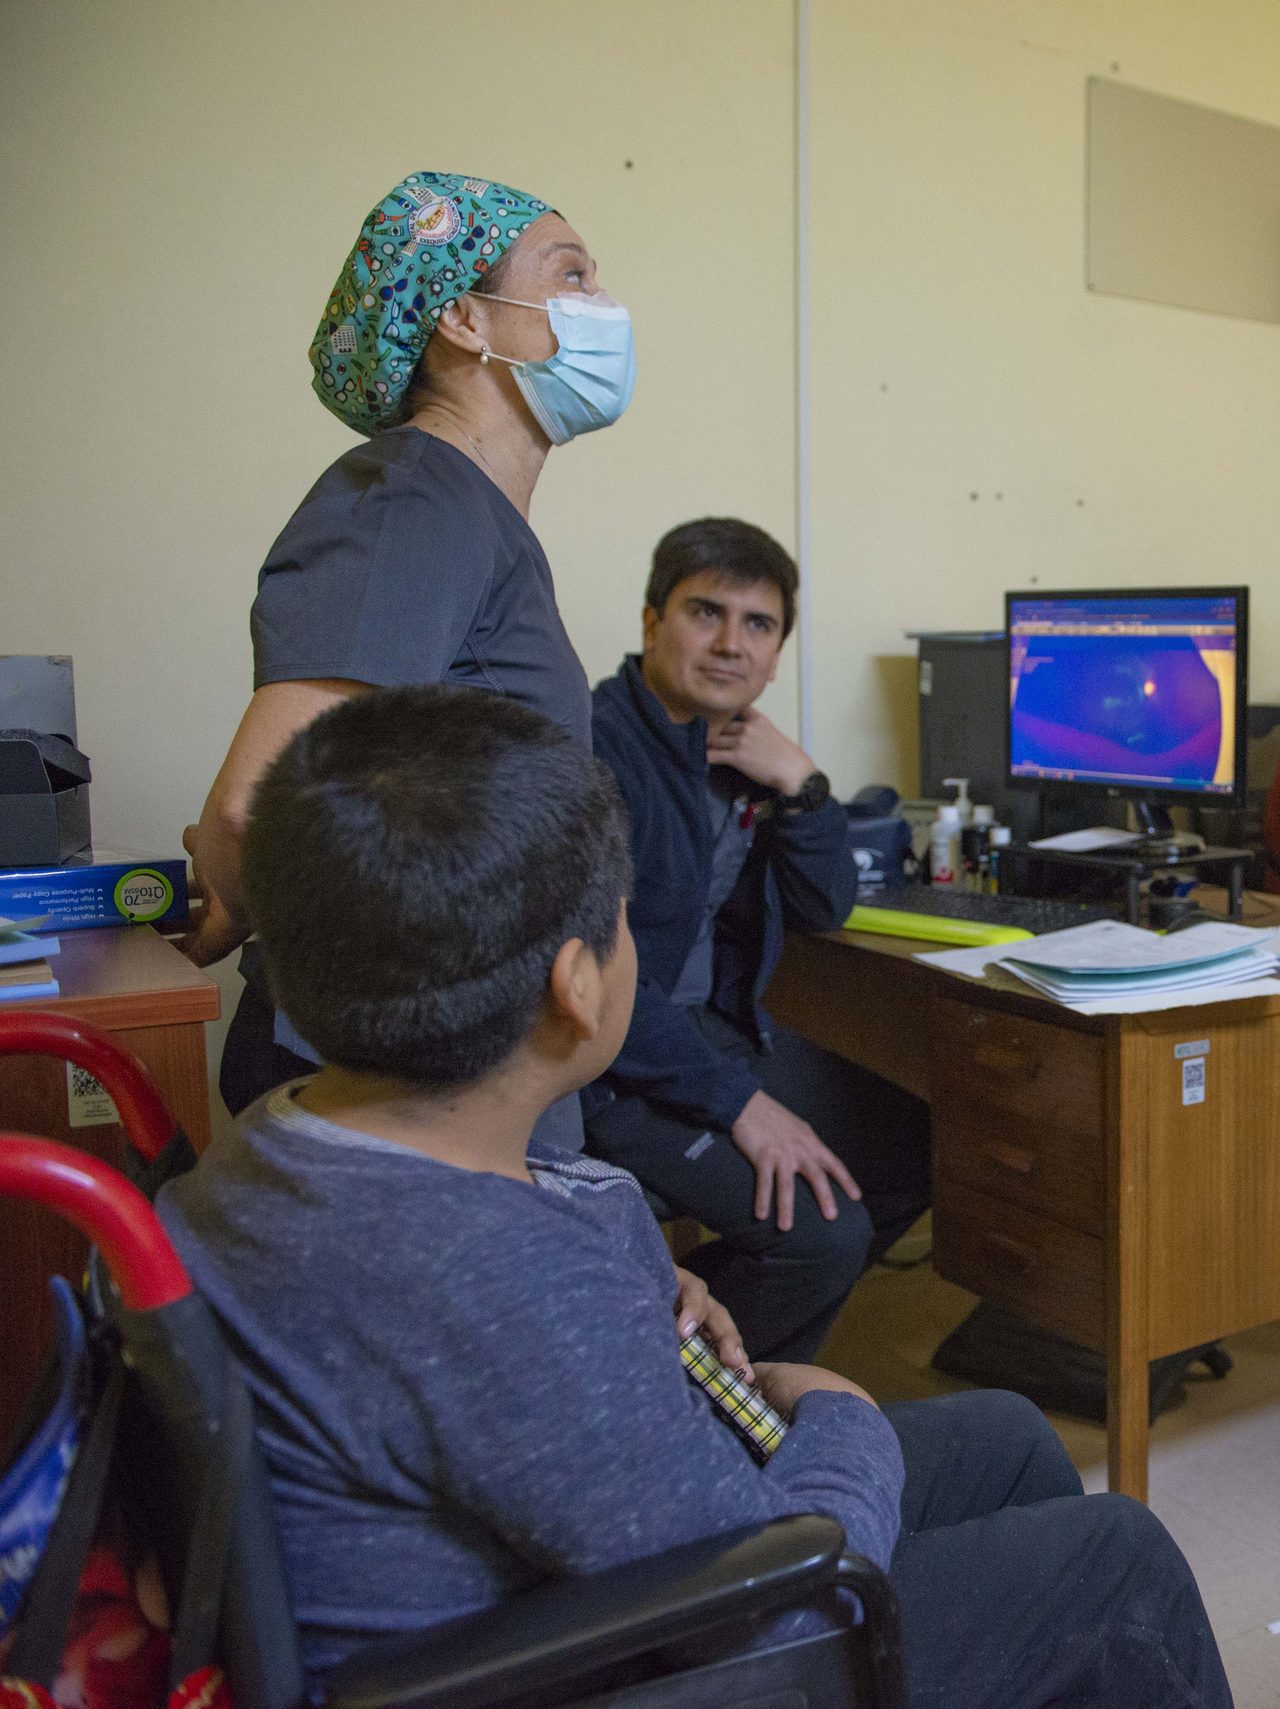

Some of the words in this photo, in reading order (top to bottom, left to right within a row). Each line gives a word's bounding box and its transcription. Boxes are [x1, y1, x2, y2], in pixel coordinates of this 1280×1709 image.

[52, 888, 95, 896] Multi-Purpose
[39, 897, 79, 905] Performance
[124, 895, 141, 906] 70
